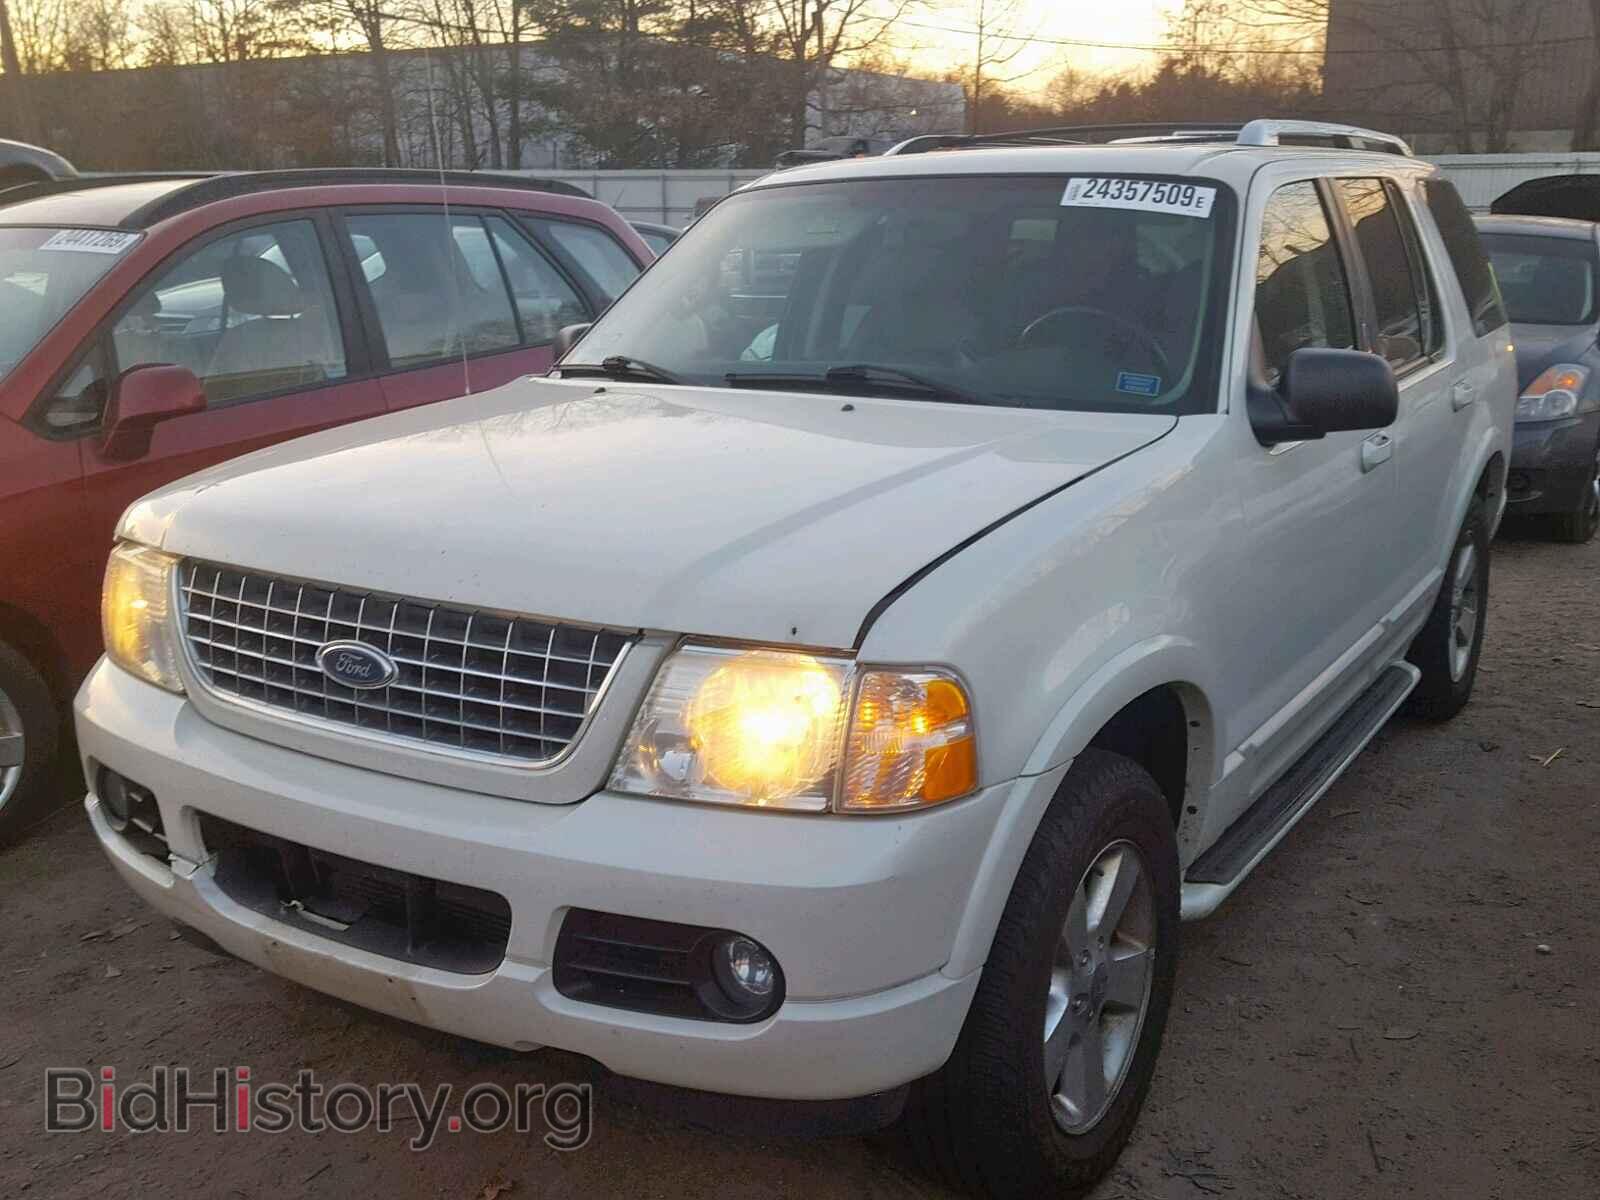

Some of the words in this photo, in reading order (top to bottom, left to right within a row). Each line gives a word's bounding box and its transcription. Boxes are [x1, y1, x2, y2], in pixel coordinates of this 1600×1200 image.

[1082, 178, 1195, 207] 24357509
[1195, 196, 1205, 209] E
[336, 653, 371, 677] Ford
